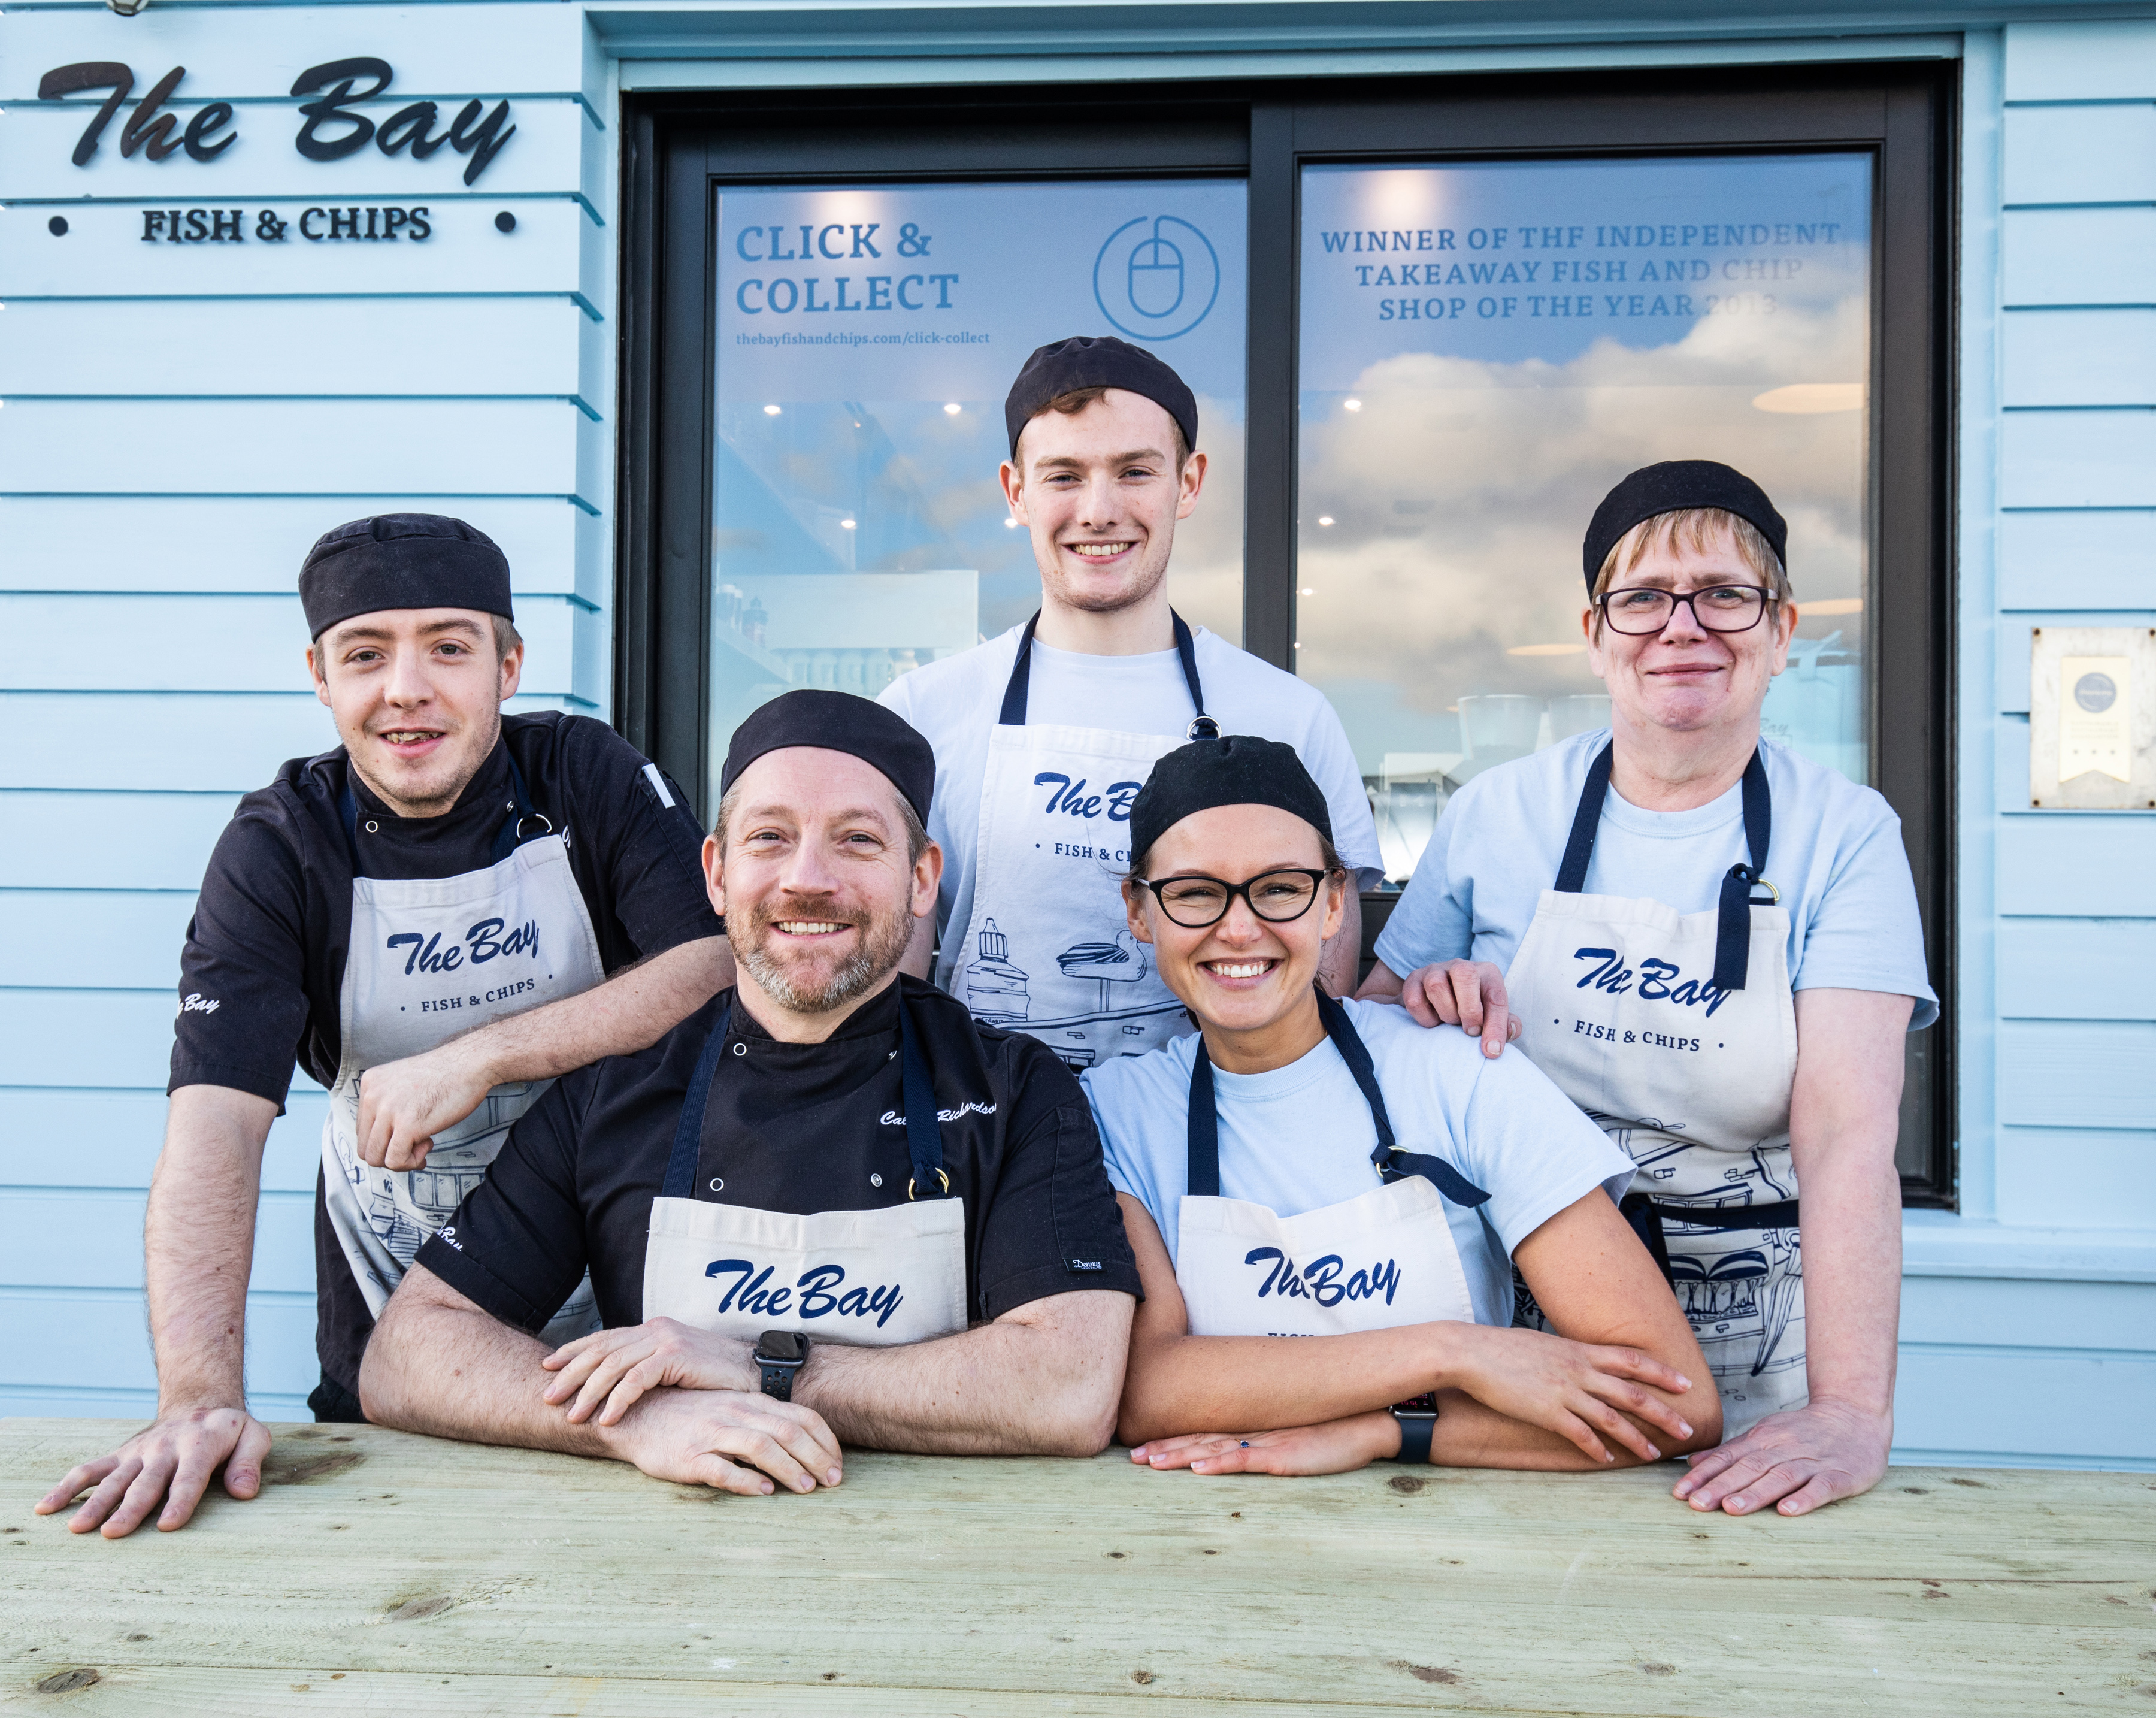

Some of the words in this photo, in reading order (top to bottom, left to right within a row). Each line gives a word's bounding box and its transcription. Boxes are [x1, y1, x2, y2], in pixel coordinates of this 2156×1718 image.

[38, 61, 237, 167] The
[290, 56, 517, 186] Bay
[141, 209, 243, 241] FISH
[256, 210, 287, 240] &
[299, 207, 431, 240] CHIPS
[1321, 229, 1456, 253] WINNER
[1468, 228, 1508, 250] OF
[1596, 223, 1841, 247] INDEPENDENT
[737, 223, 881, 262] CLICK
[897, 222, 932, 258] &
[1355, 261, 1542, 286] TAKEAWAY
[1552, 260, 1627, 282] FISH
[1639, 259, 1710, 282] AND
[1722, 258, 1803, 281] CHIP
[736, 274, 959, 314] COLLECT
[1379, 298, 1466, 320] SHOP
[1477, 297, 1517, 319] OF
[1527, 295, 1592, 317] THE
[1604, 294, 1694, 316] YEAR
[1706, 294, 1778, 315] 2013
[736, 332, 990, 347] thebayfishandchips.com/click-collect
[1034, 772, 1102, 818] The
[1055, 843, 1092, 858] FISH
[1099, 848, 1110, 860] &
[387, 932, 464, 975] The
[465, 917, 539, 964] Bay
[184, 993, 220, 1014] Bay
[421, 997, 462, 1012] FISH
[469, 995, 480, 1005] &
[486, 978, 535, 1002] CHIPS
[1638, 958, 1731, 1018] Bay
[1574, 1020, 1615, 1041] FISH
[1623, 1030, 1636, 1043] &
[1642, 1032, 1700, 1051] CHIPS
[937, 1102, 997, 1121] Richardso
[1073, 1259, 1101, 1269] Dennys
[1303, 1254, 1401, 1307] Bay
[705, 1259, 792, 1316] The
[797, 1265, 903, 1328] Bay
